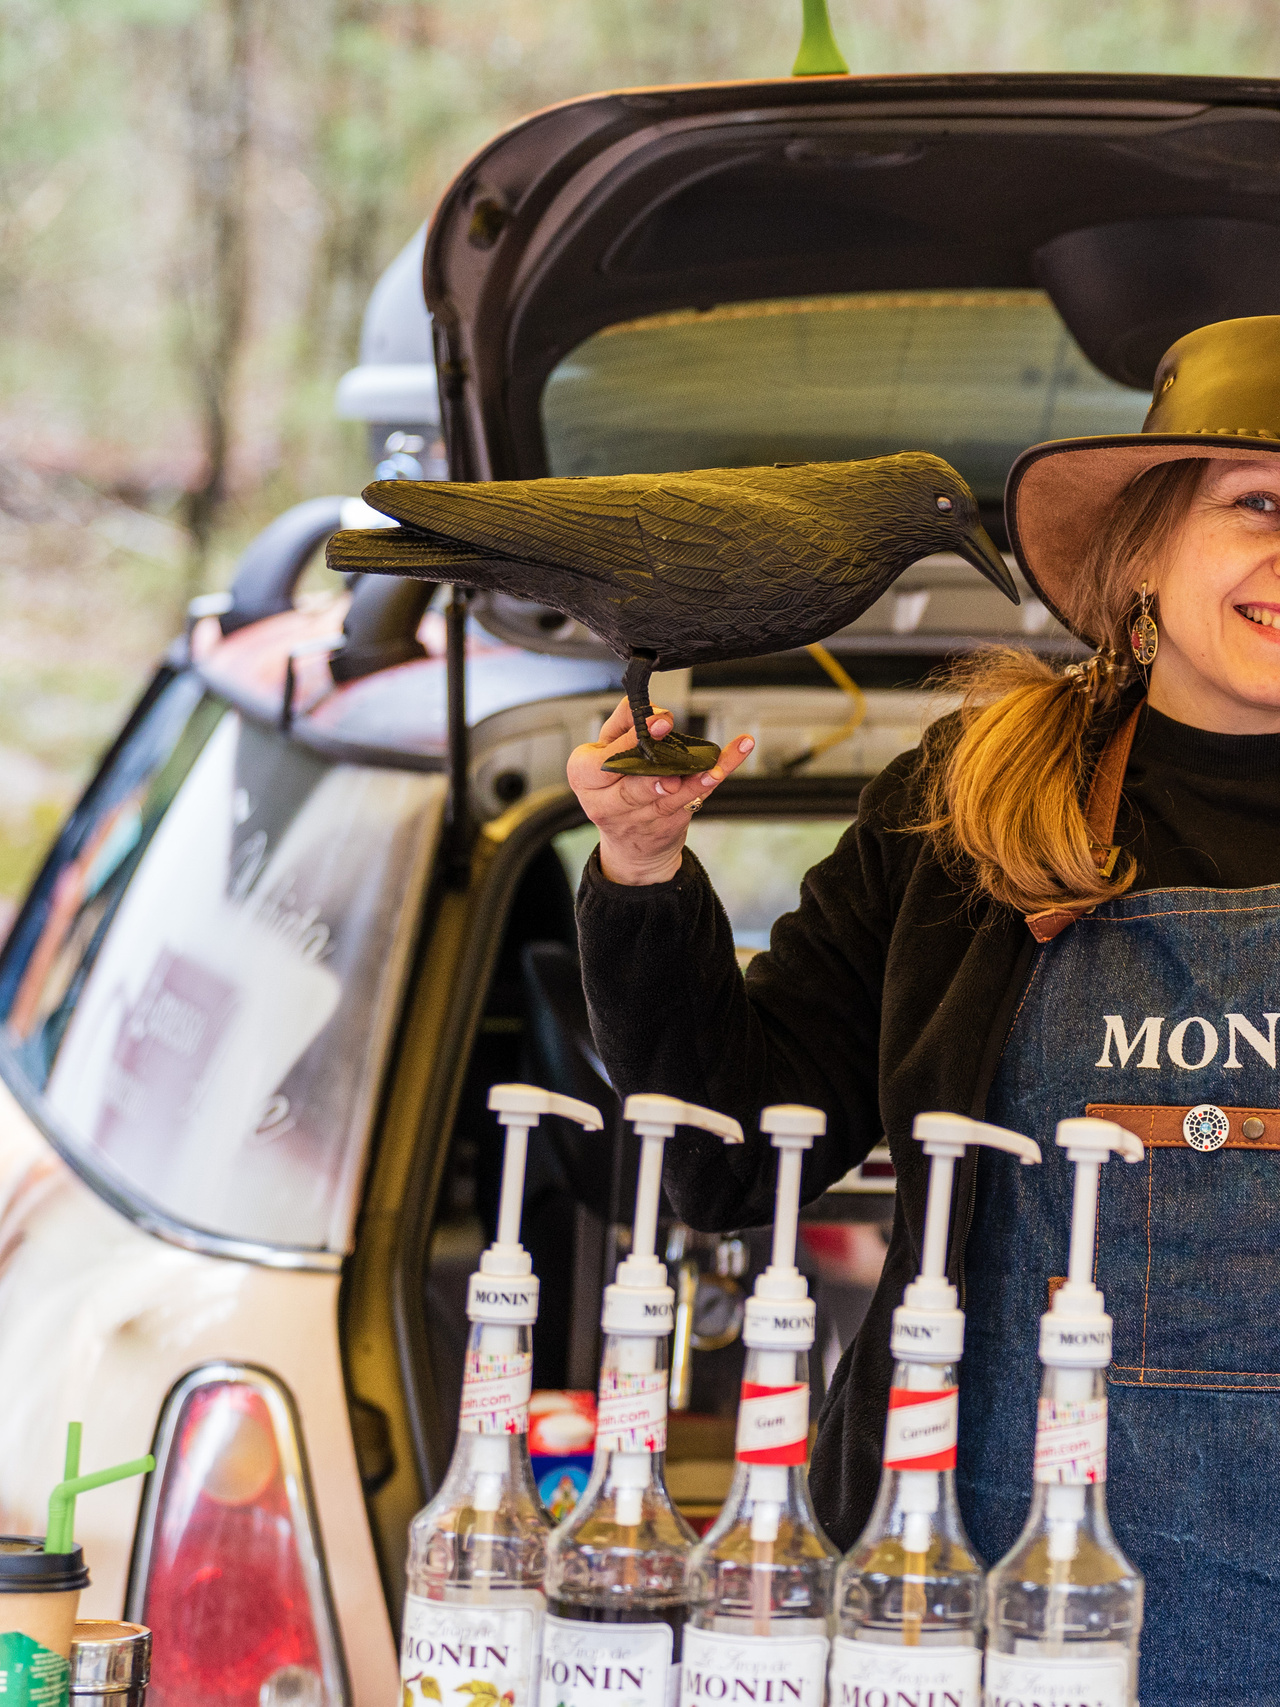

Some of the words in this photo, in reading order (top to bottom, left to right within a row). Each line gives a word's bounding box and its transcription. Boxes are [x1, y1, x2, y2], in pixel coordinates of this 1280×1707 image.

[475, 1289, 530, 1306] MONIN
[901, 1418, 951, 1441] Caramel
[686, 1669, 804, 1702] MONIN
